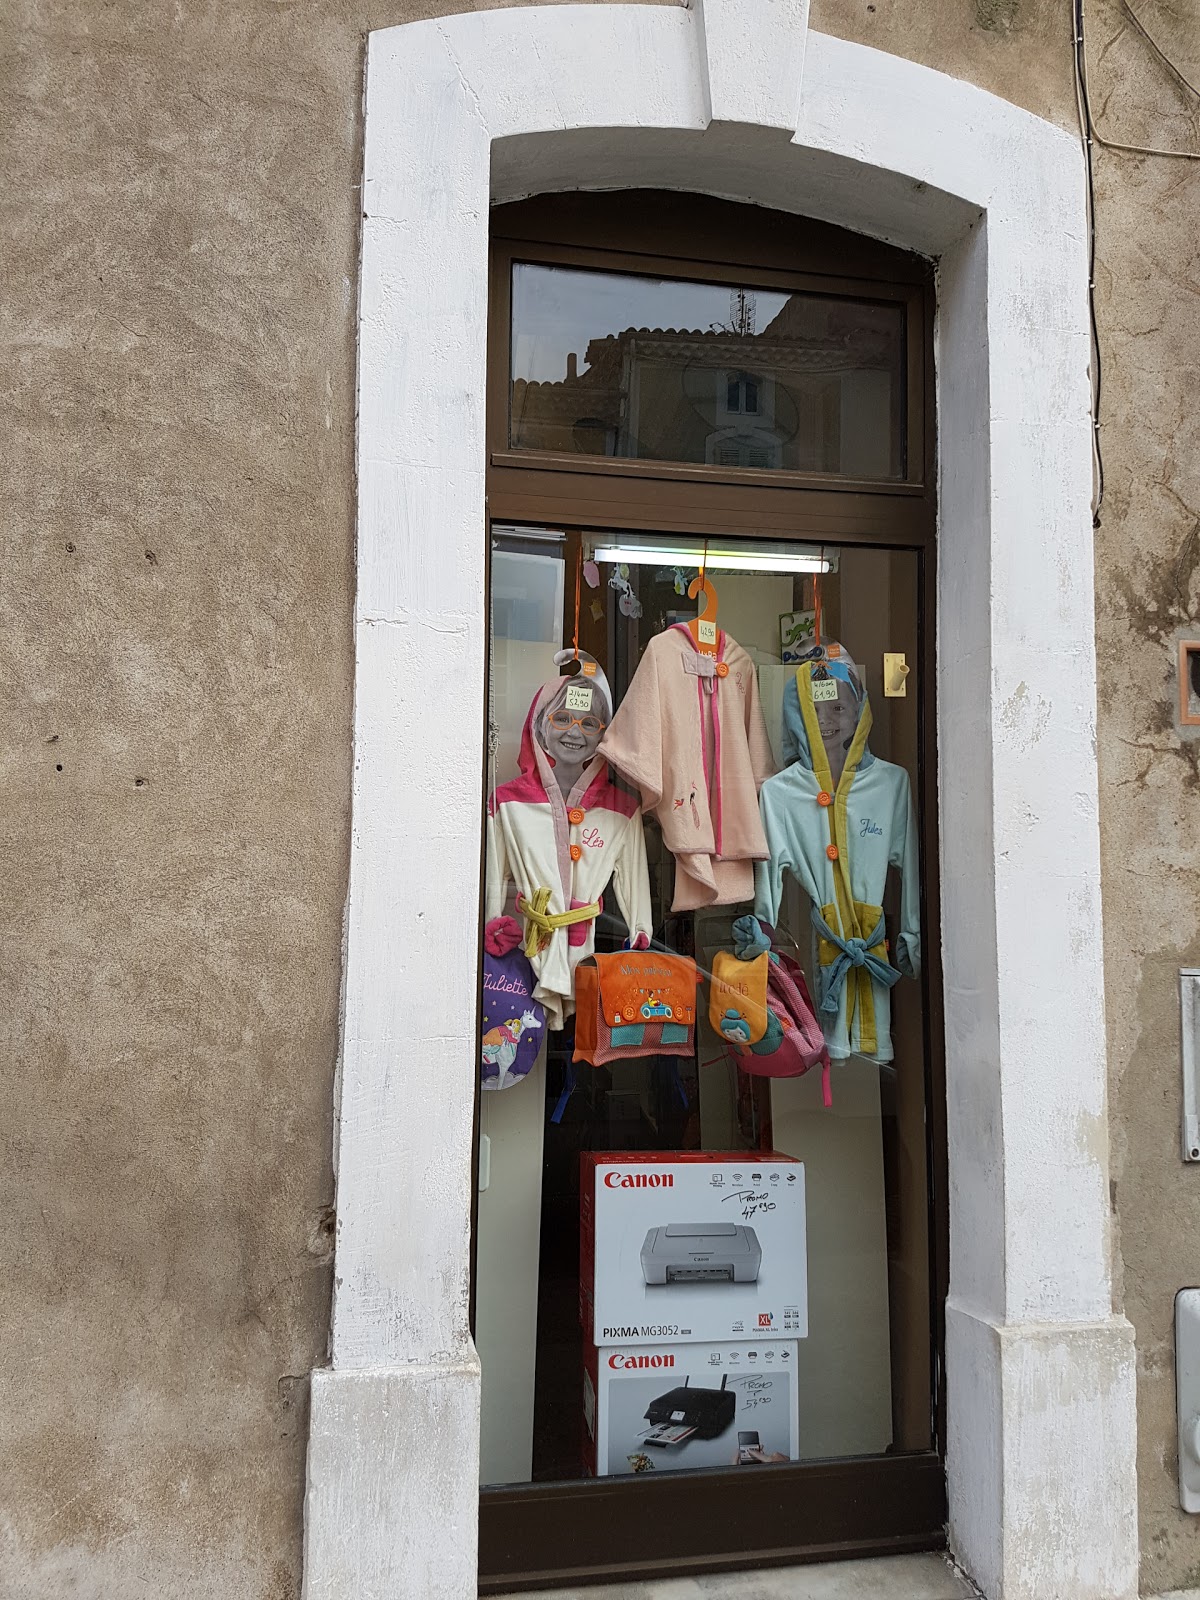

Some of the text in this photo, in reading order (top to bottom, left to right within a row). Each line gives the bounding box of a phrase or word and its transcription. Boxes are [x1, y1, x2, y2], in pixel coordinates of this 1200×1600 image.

[860, 818, 883, 838] Jules
[582, 828, 604, 848] Léa
[484, 973, 529, 996] Juliette
[604, 1171, 674, 1189] Canon
[759, 1315, 770, 1325] XL
[602, 1327, 640, 1338] PIXMA
[641, 1325, 679, 1337] MG3052
[608, 1354, 675, 1370] Canon
